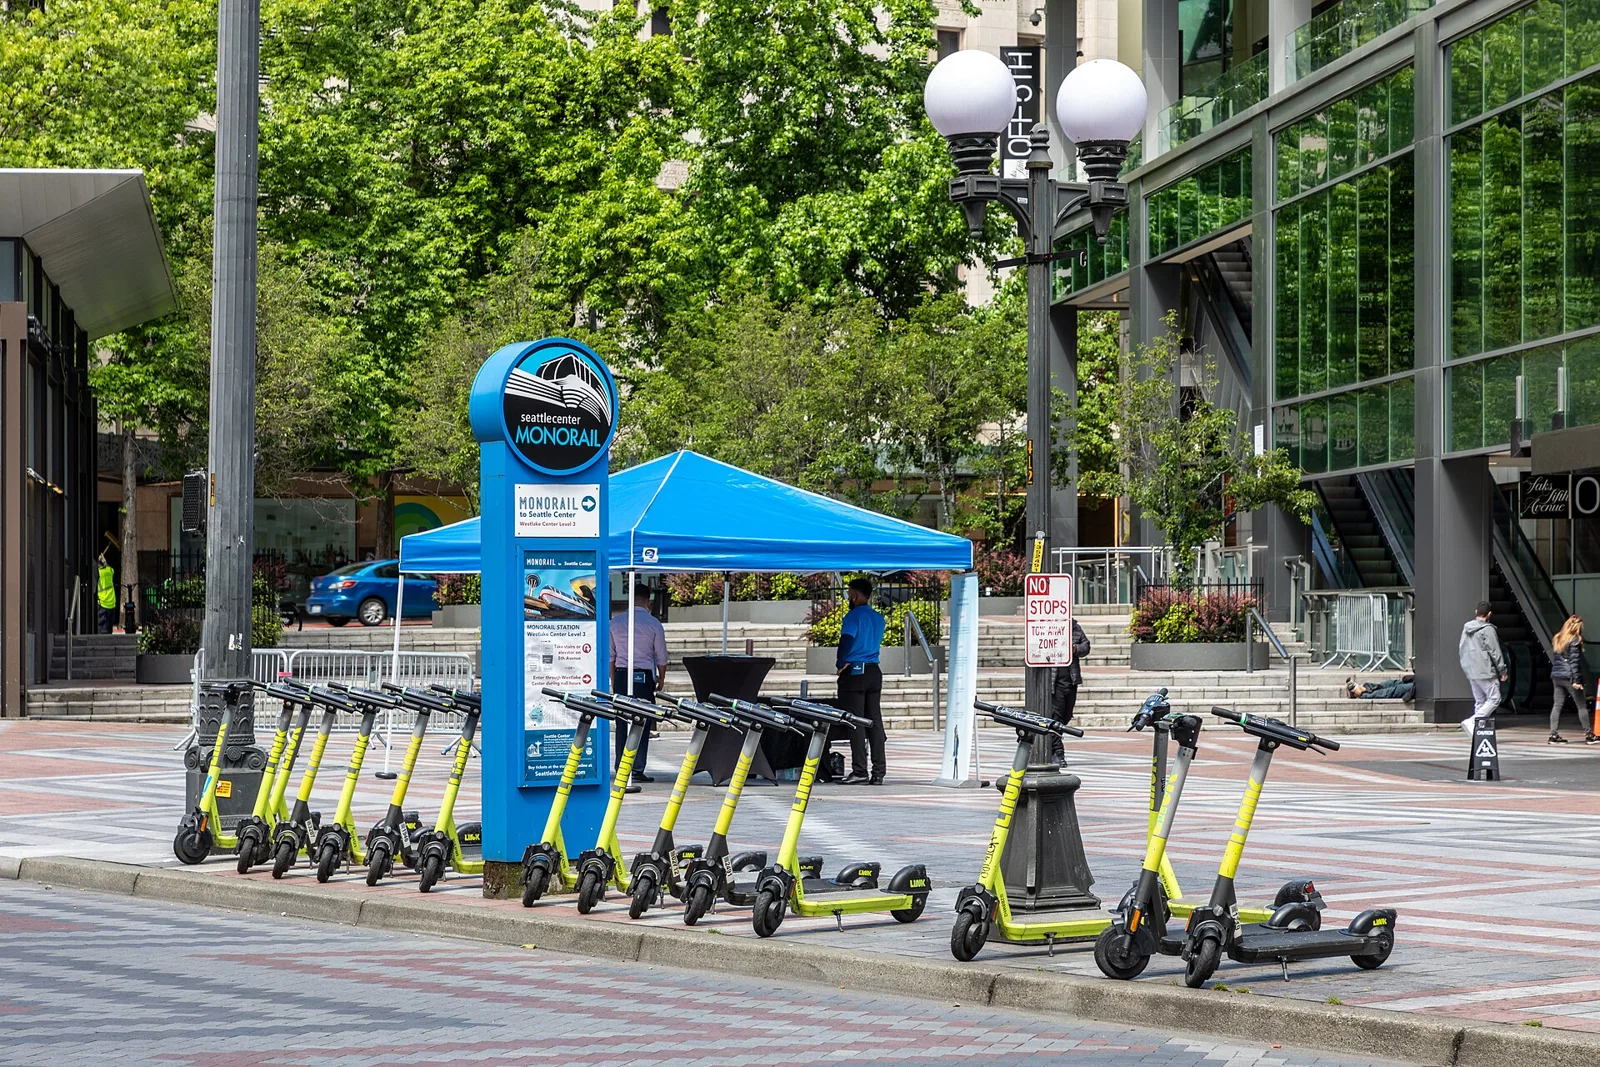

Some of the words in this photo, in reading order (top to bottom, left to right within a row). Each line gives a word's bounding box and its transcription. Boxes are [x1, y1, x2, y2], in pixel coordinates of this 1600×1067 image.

[520, 412, 581, 425] seattlecenter
[515, 425, 601, 447] MONORAIL
[1522, 476, 1553, 494] Saks
[519, 496, 579, 511] MONORAIL
[1521, 497, 1565, 515] Avenue
[526, 558, 556, 566] MONORAIL
[1029, 577, 1048, 594] NO
[1030, 600, 1067, 615] STOPS
[995, 768, 1025, 827] LINK
[858, 869, 873, 877] LINK
[909, 879, 926, 888] LINK
[1372, 917, 1388, 926] LINK
